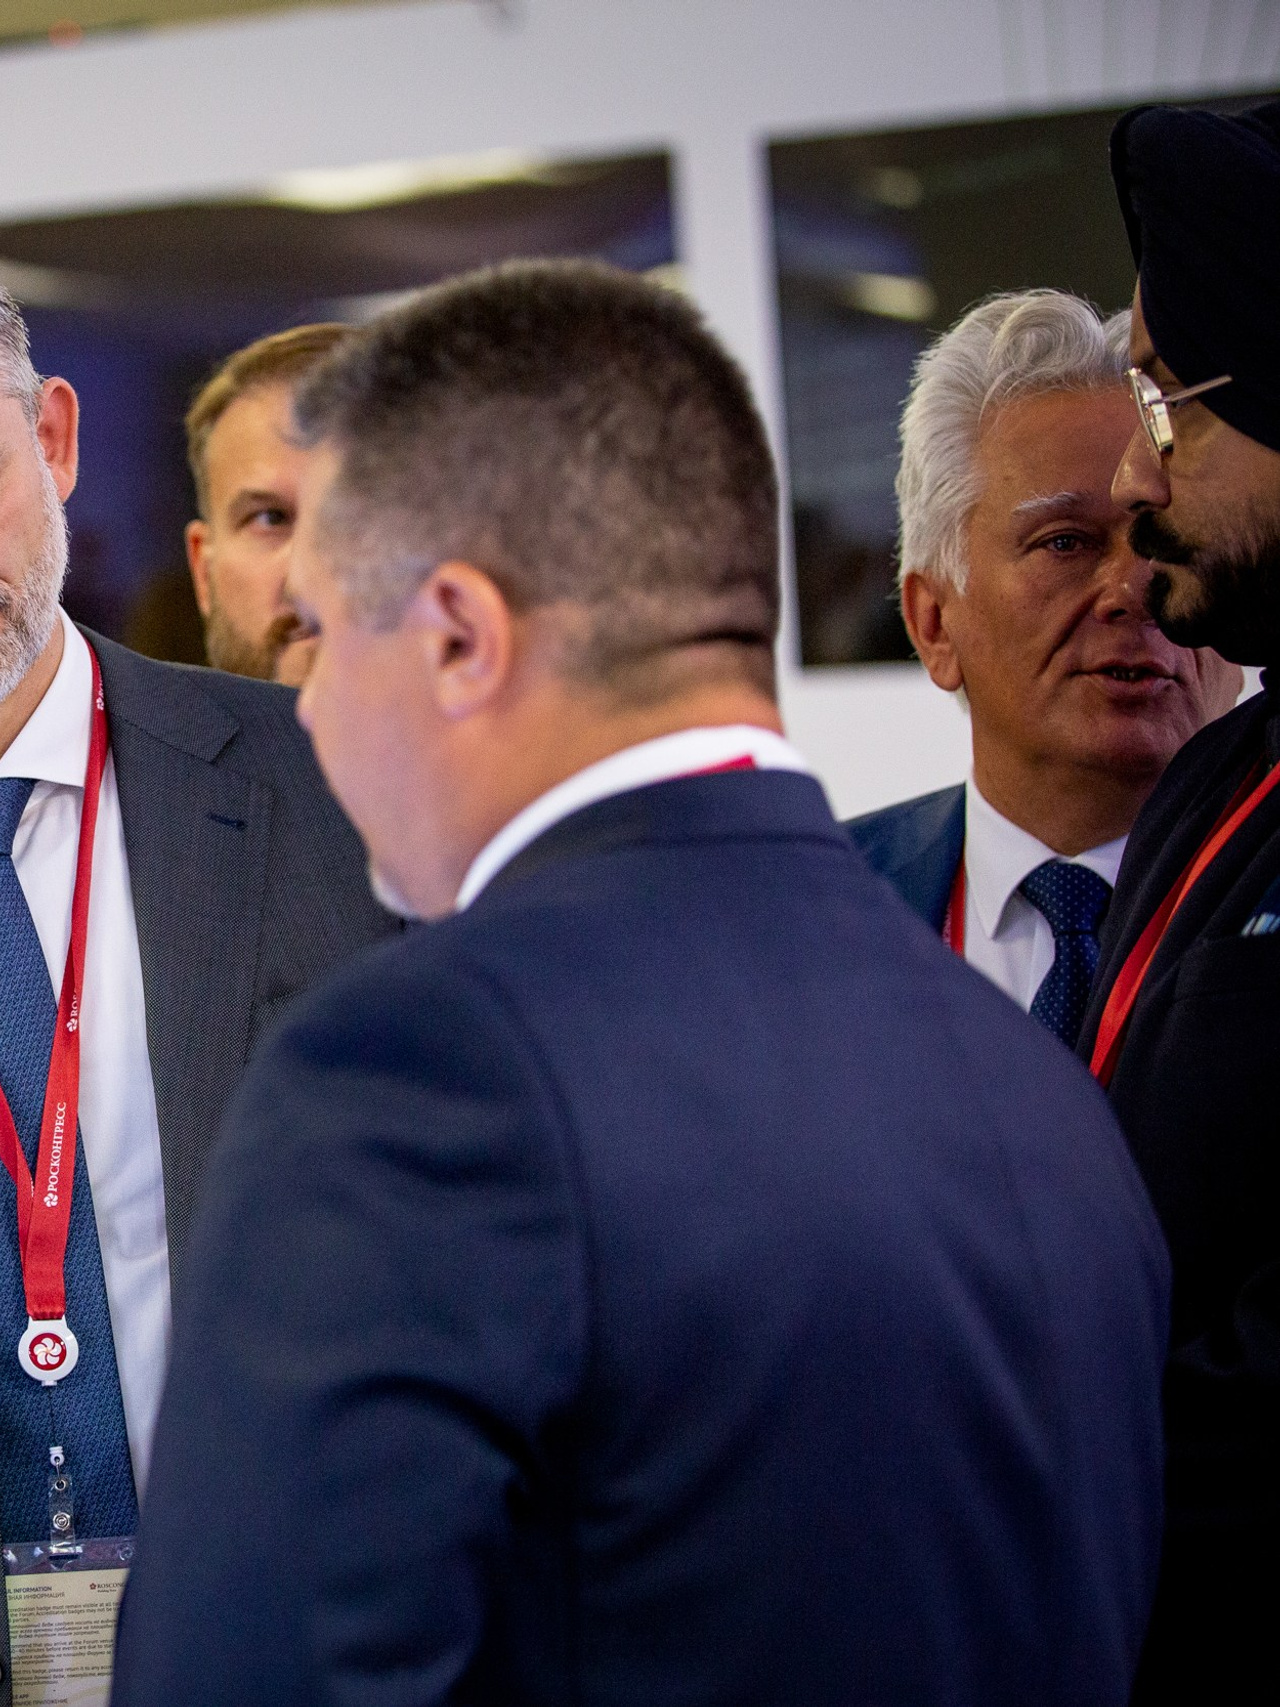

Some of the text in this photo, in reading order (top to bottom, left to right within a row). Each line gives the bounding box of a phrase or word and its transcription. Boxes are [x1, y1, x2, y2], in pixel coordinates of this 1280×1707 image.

[47, 1101, 67, 1192] РОСКОНГРЕСС
[14, 1586, 52, 1594] INFORMATION
[23, 1592, 65, 1600] ИНФОРМАЦИЯ
